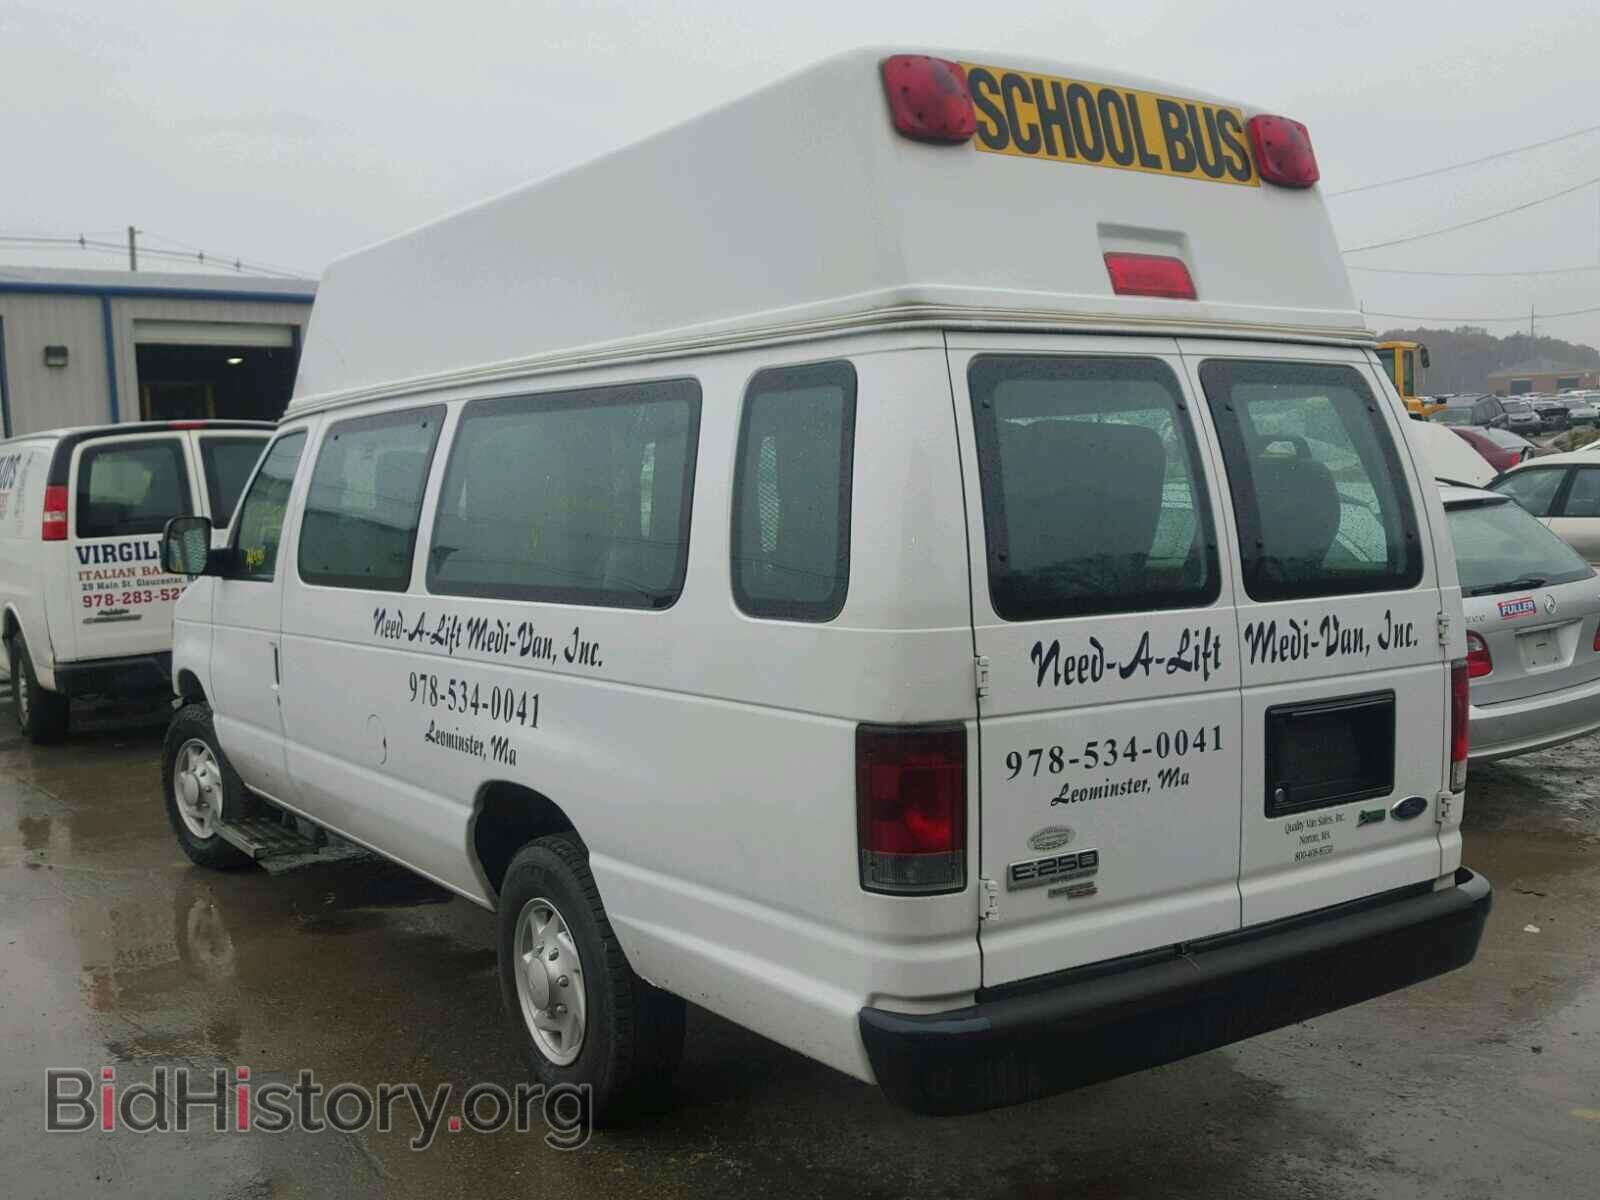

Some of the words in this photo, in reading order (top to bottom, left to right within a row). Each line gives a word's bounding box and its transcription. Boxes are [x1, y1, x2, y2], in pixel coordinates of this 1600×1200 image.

[967, 67, 1163, 169] SCHOOL
[1157, 99, 1253, 183] BUS
[75, 541, 162, 564] VIRGIL
[78, 567, 136, 581] ITALIAN
[142, 566, 162, 576] BA
[97, 581, 119, 590] Main
[1502, 601, 1534, 616] FULLER
[373, 607, 462, 656] Need-A-Lift
[466, 616, 558, 665] Medi-Van,
[564, 626, 603, 667] Inc.
[1030, 626, 1222, 688] Need-A-Lift
[1245, 614, 1371, 664] Medi-Van,
[1378, 609, 1419, 651] Inc.
[408, 671, 541, 728] 978-534-0041
[424, 719, 487, 760] Leominster,
[490, 735, 517, 767] Ma
[1005, 724, 1224, 780] 978-534-0041
[1050, 778, 1151, 806] Leominster,
[1157, 766, 1190, 790] Ma
